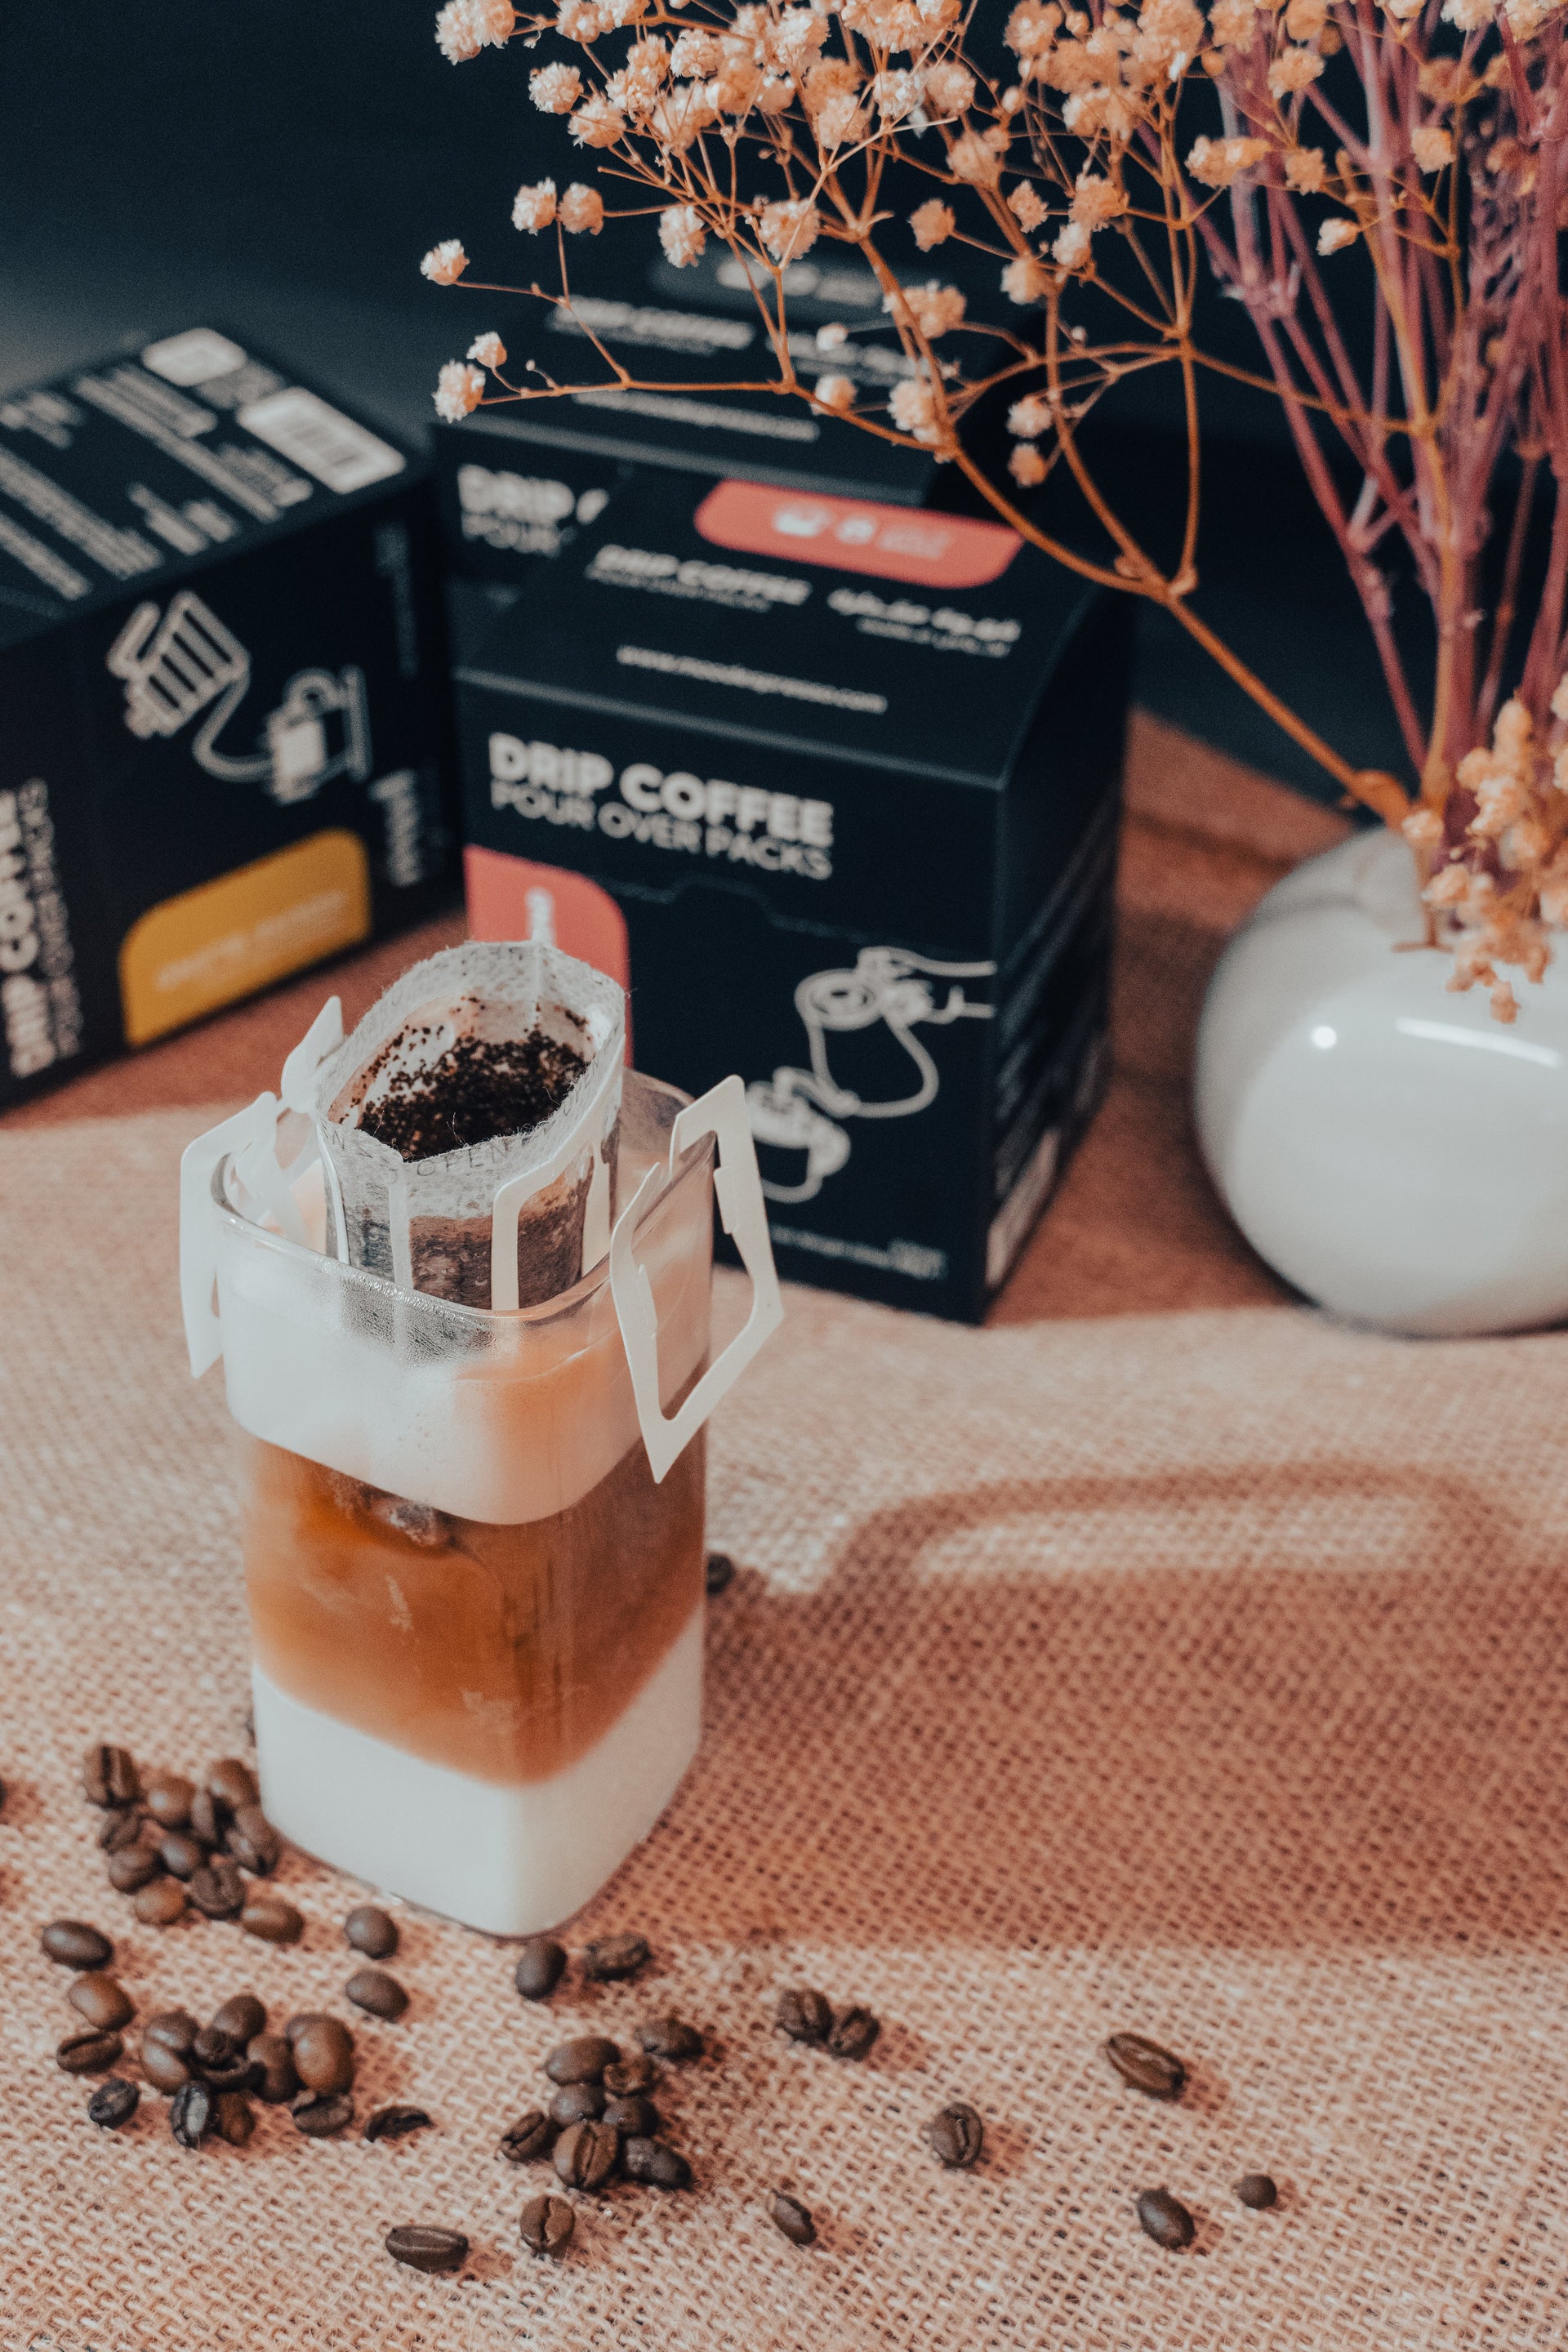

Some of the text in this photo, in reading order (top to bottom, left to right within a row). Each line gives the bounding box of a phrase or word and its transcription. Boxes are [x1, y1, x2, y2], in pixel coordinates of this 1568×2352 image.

[457, 464, 576, 524] DRIP
[489, 732, 835, 849] DRIP COFFEE
[490, 777, 596, 832] POUR
[597, 802, 703, 855] OVER
[704, 824, 834, 880] PACKS
[416, 1138, 512, 1177] OPEN
